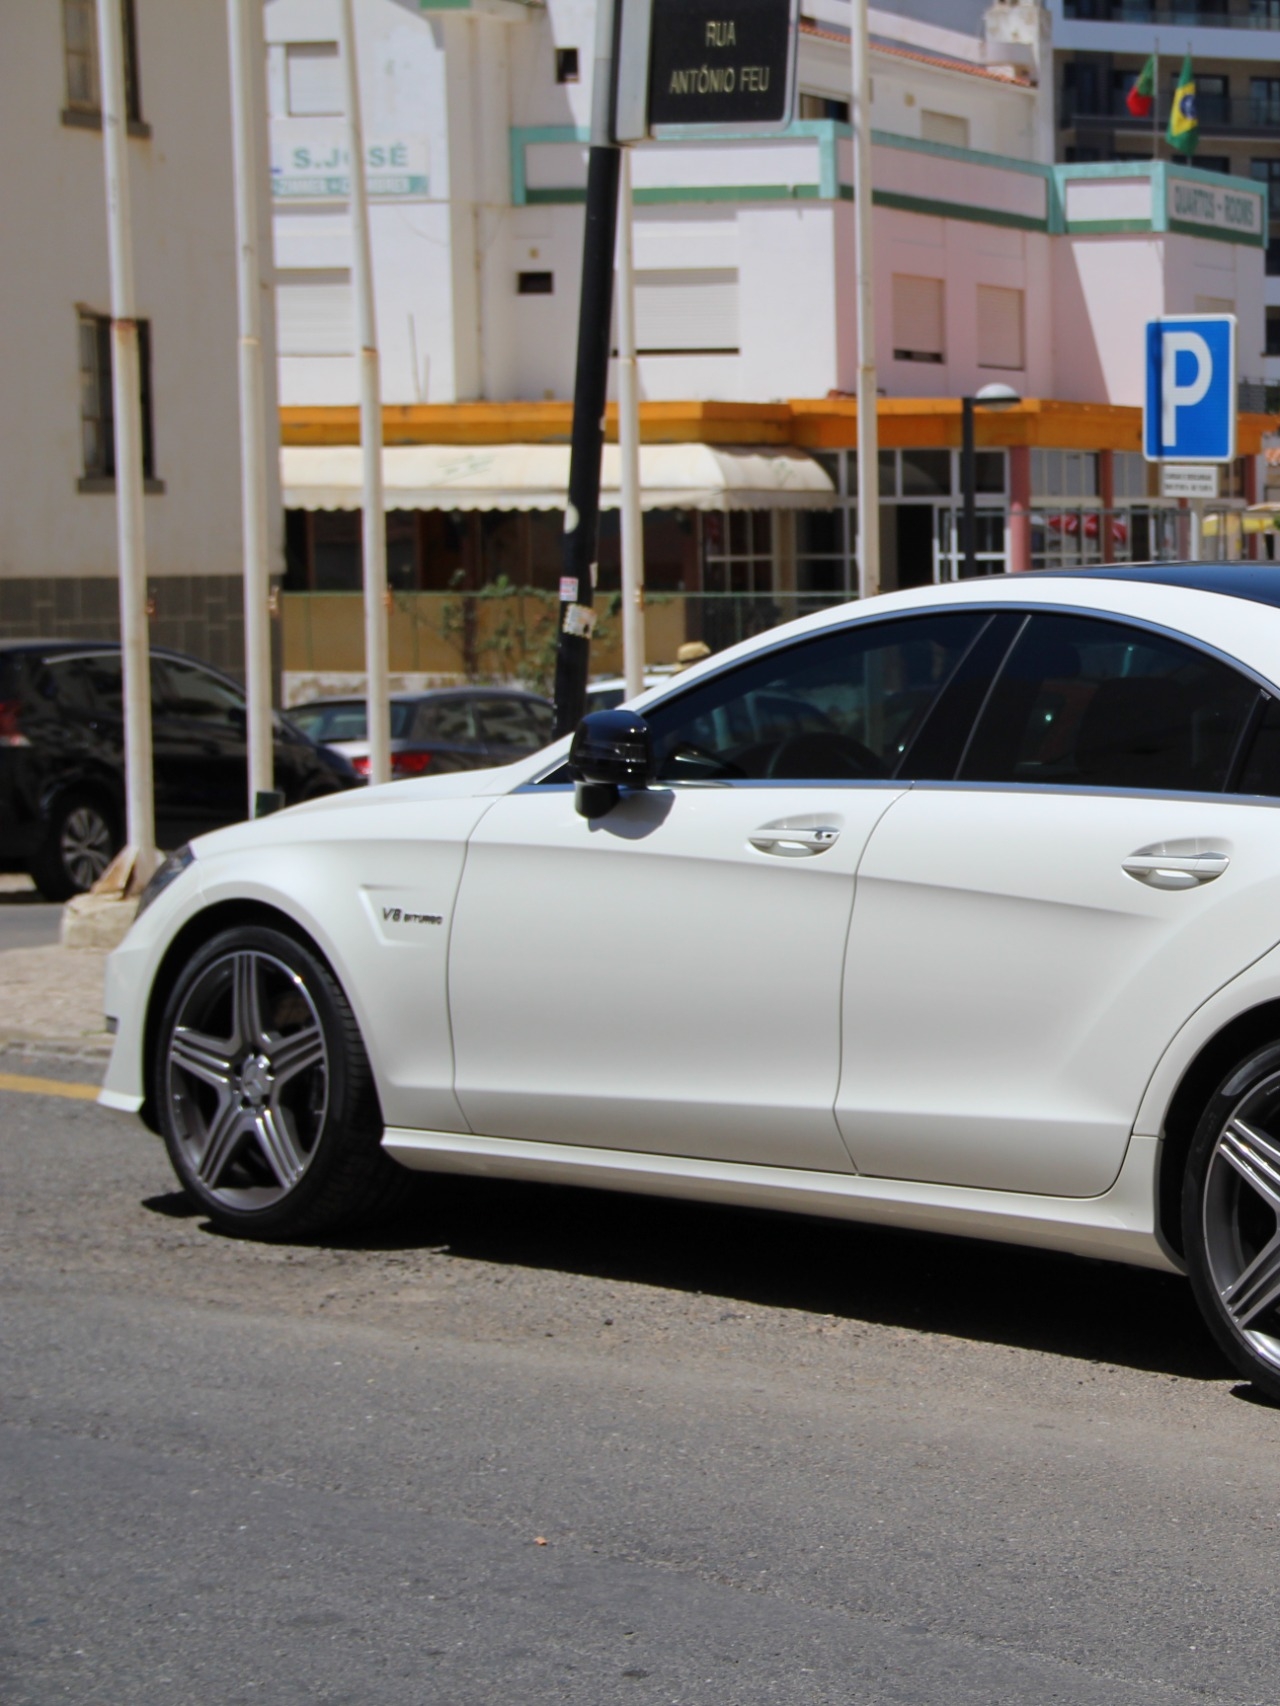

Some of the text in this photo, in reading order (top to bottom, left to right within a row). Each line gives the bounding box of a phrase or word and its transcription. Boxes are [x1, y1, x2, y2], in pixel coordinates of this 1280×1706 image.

[705, 21, 736, 47] RUA
[669, 64, 770, 94] ANTÓNIO FEU
[293, 141, 408, 169] S.JSÉ
[1224, 194, 1255, 227] ROOMS
[1162, 331, 1213, 447] P
[383, 907, 442, 925] V8 BITURBO
